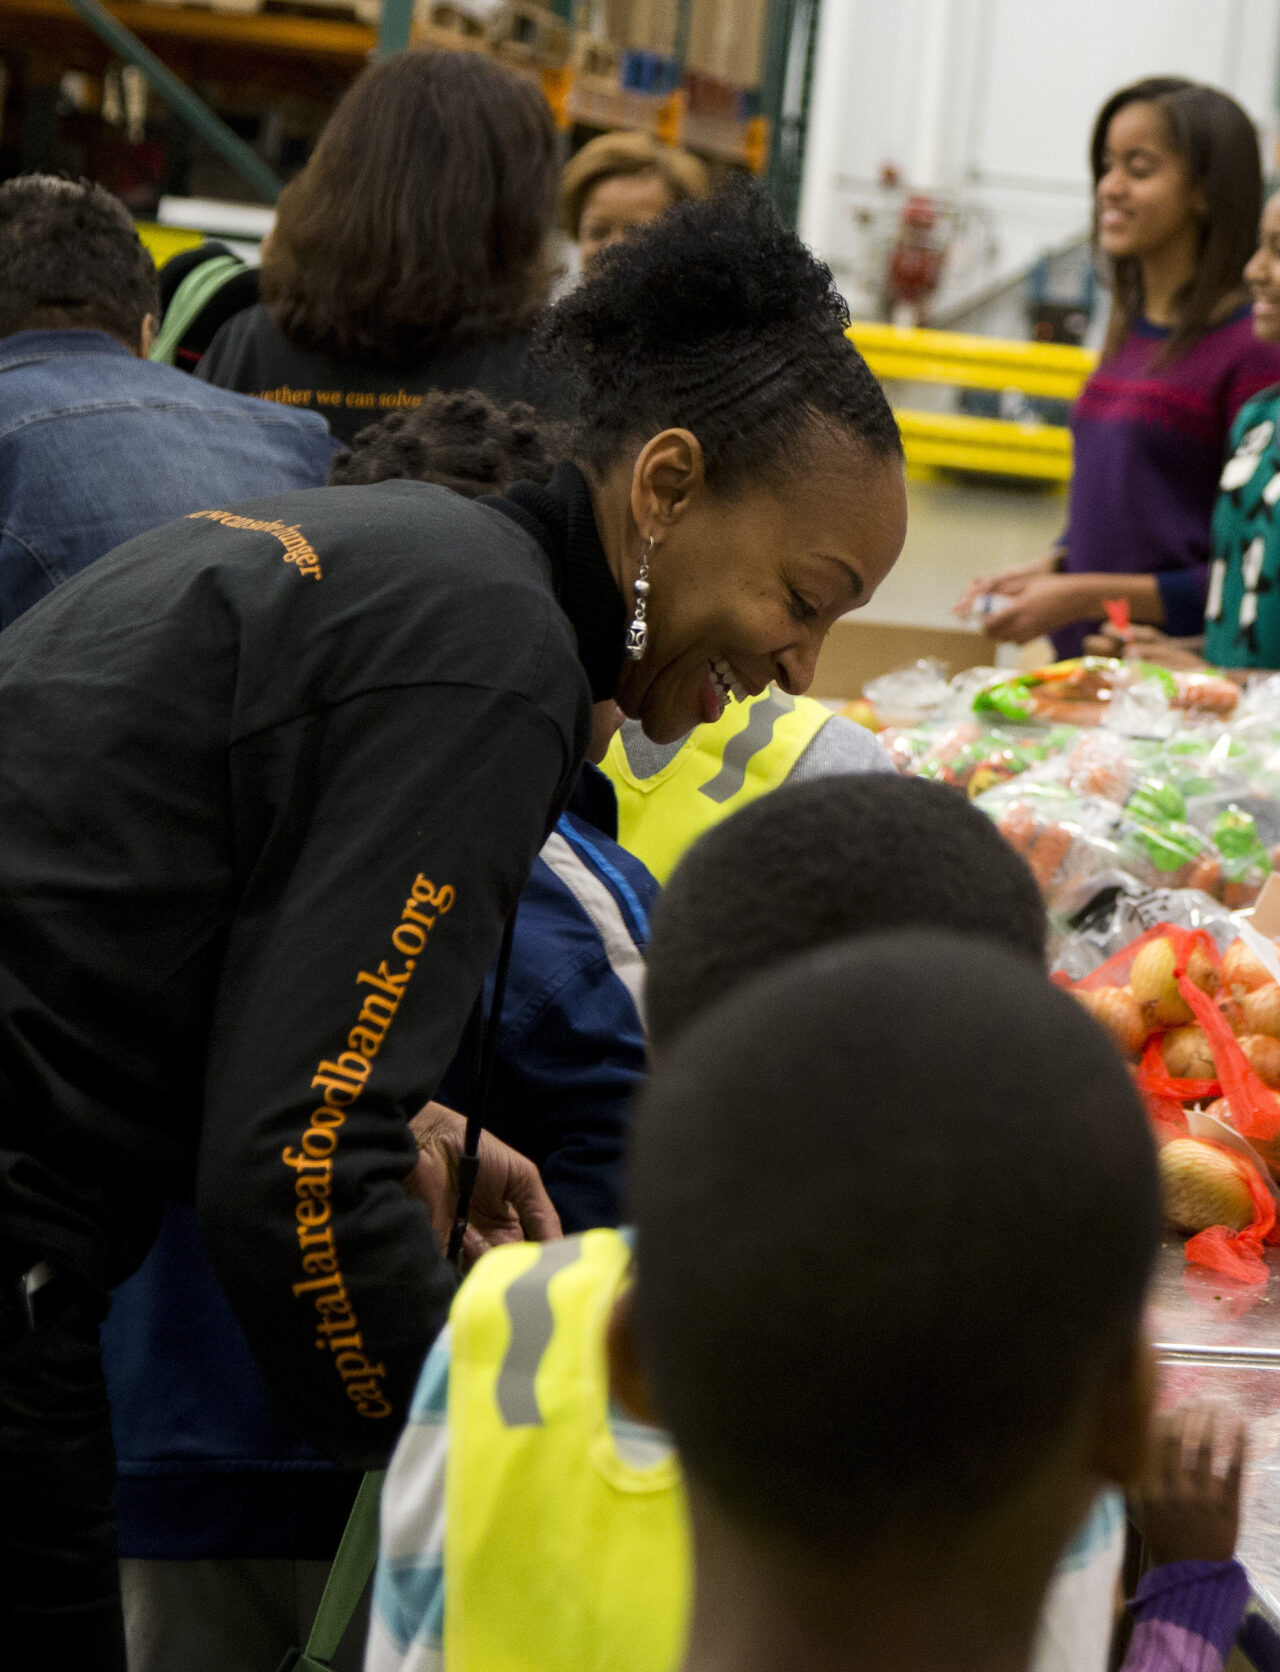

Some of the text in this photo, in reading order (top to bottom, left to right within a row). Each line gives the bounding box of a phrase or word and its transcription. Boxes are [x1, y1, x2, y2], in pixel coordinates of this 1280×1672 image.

[315, 390, 343, 407] we
[345, 392, 375, 409] can
[377, 388, 424, 408] solve
[271, 523, 323, 580] hunger
[282, 873, 456, 1419] capitalareafoodbank.org
